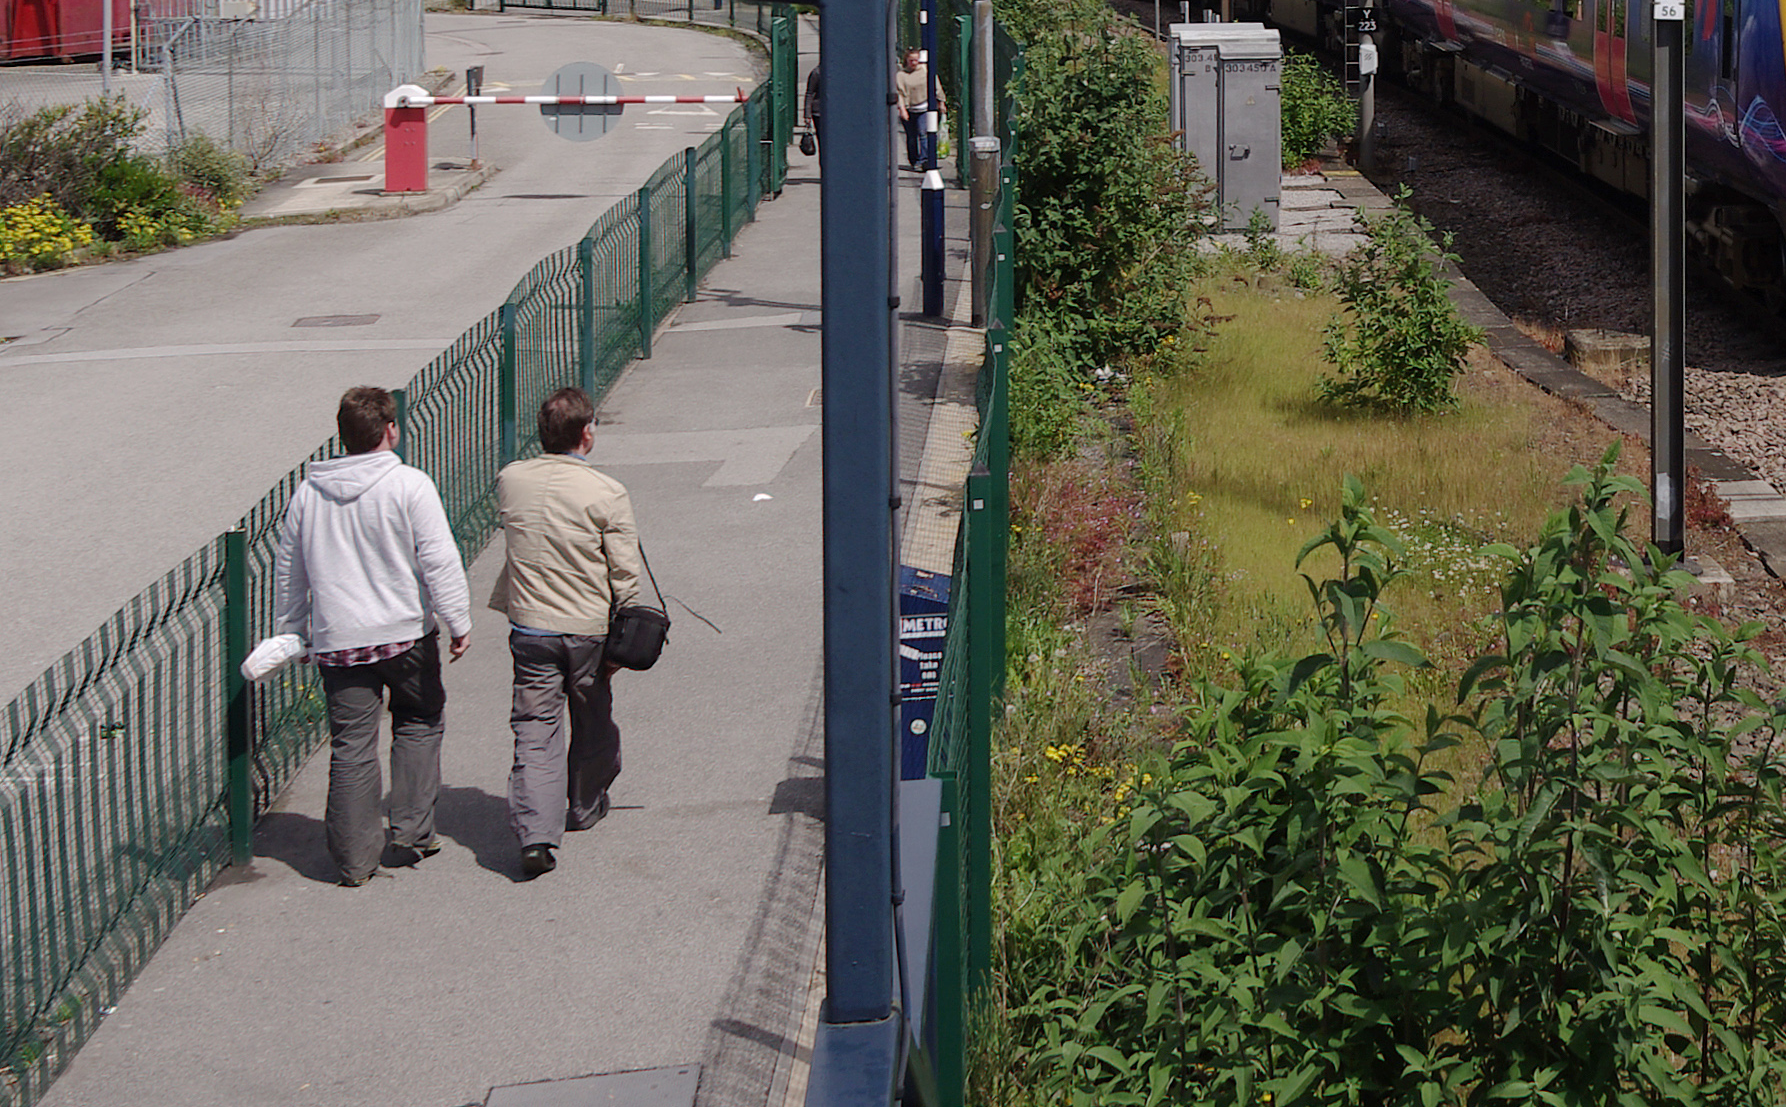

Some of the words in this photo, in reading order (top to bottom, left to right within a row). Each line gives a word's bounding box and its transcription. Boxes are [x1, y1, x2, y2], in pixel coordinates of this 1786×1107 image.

[1362, 9, 1371, 19] Y
[1661, 5, 1676, 17] 56
[1358, 20, 1377, 31] 223
[1270, 64, 1277, 72] A
